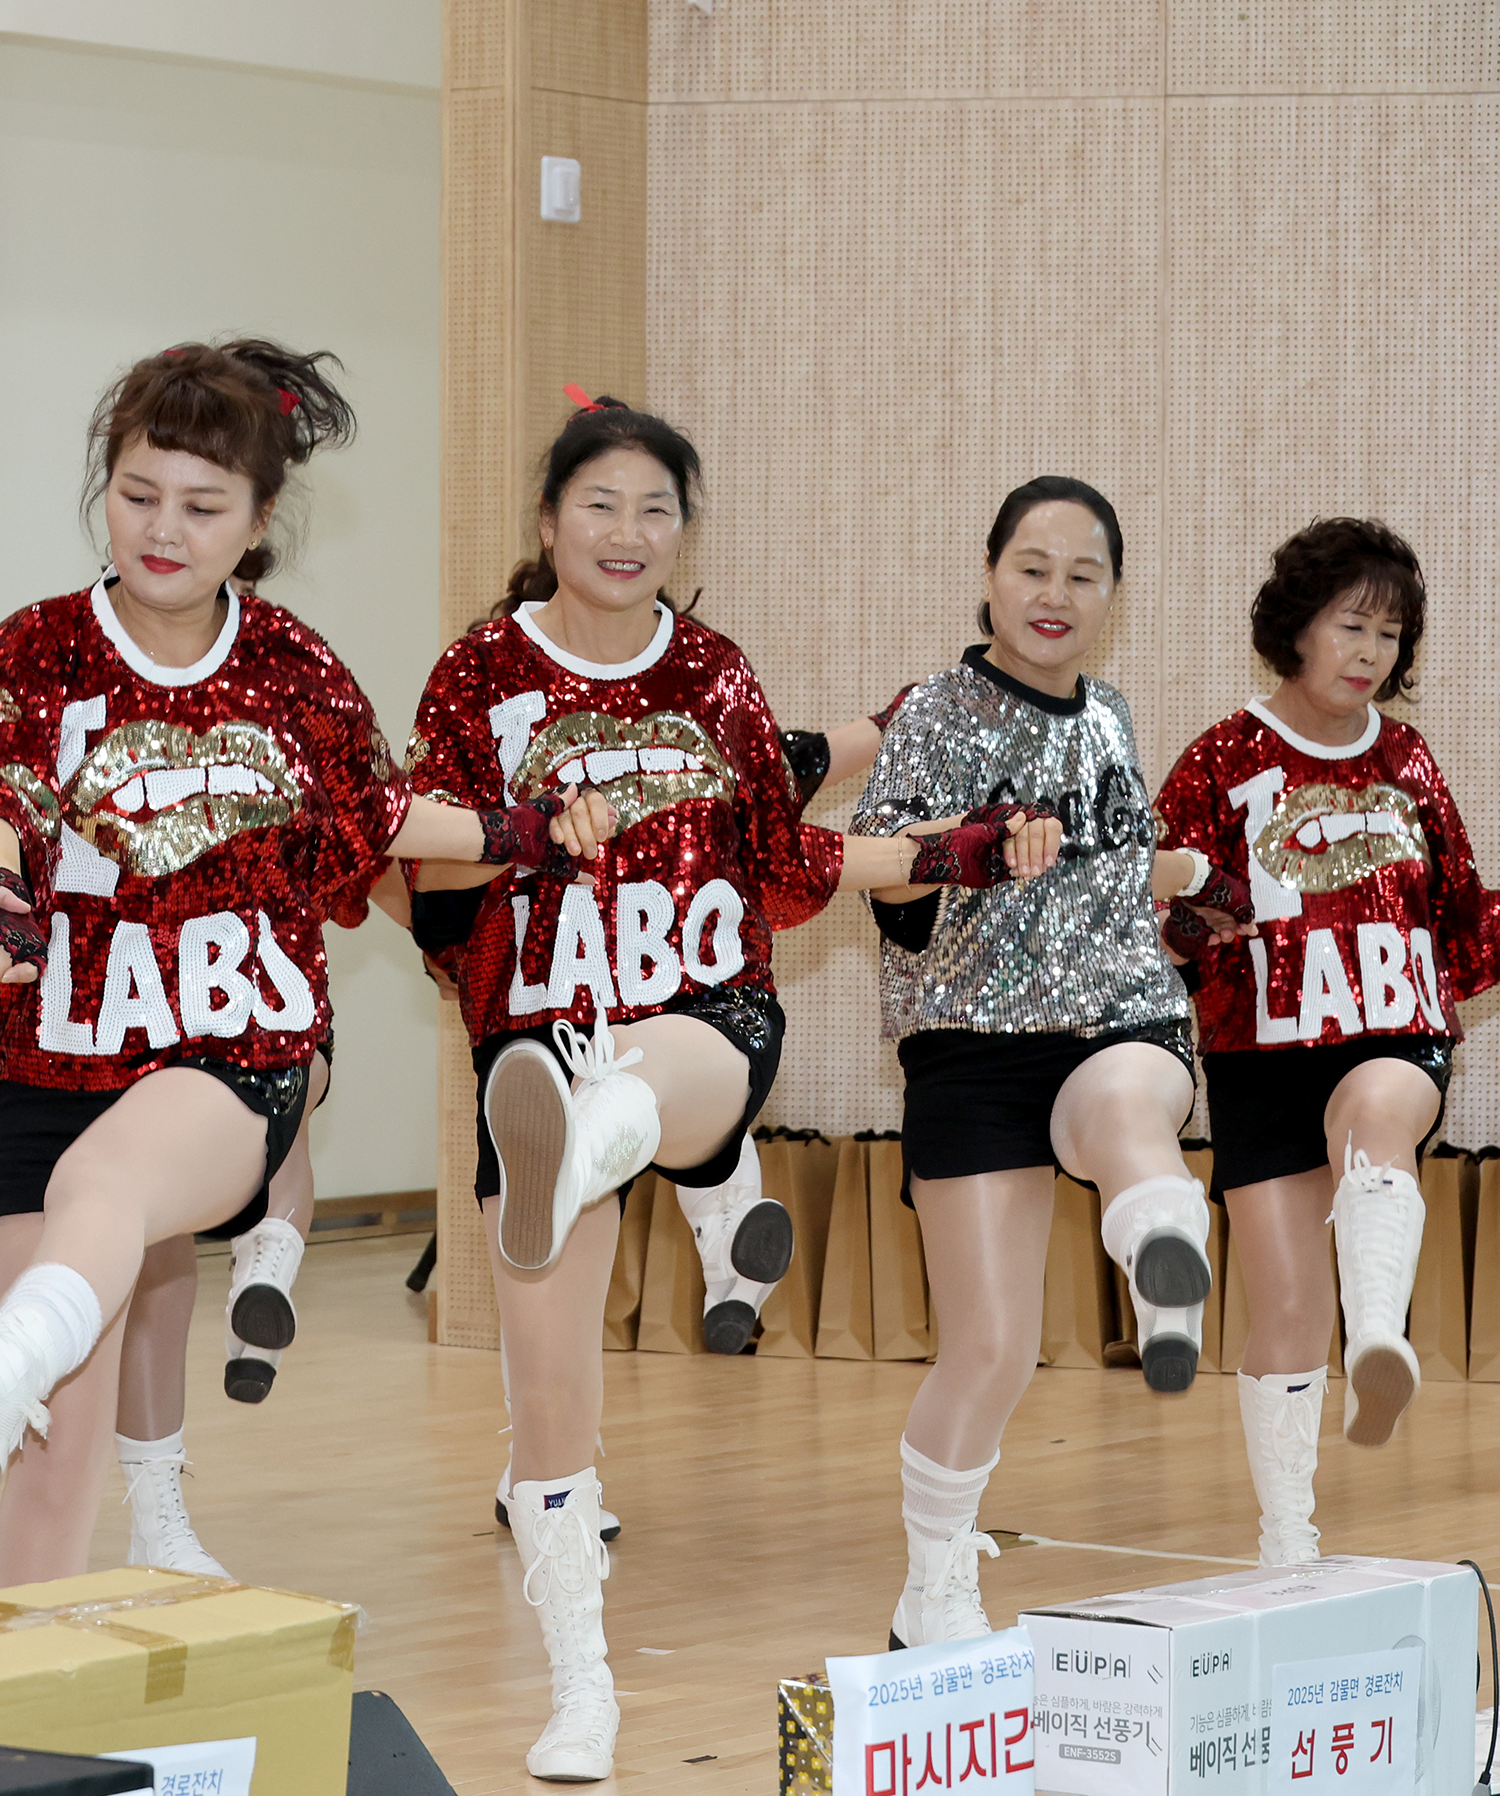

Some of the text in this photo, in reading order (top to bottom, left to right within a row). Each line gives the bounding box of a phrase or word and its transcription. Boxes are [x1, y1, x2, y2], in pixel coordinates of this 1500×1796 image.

[1227, 765, 1303, 923] I
[508, 878, 745, 1016] LABO
[1248, 921, 1447, 1045] LABO
[868, 1649, 1035, 1707] 2025년 감물면 경로잔치
[1287, 1670, 1404, 1707] 2025년 감물면 경로잔치
[1034, 1710, 1150, 1745] 베이직 선풍기
[1092, 1699, 1122, 1715] 바람은
[1123, 1702, 1163, 1719] 강력하게
[1190, 1711, 1215, 1734] 기능은
[1063, 1746, 1117, 1762] ENF-3552S
[1190, 1732, 1237, 1779] 베이직
